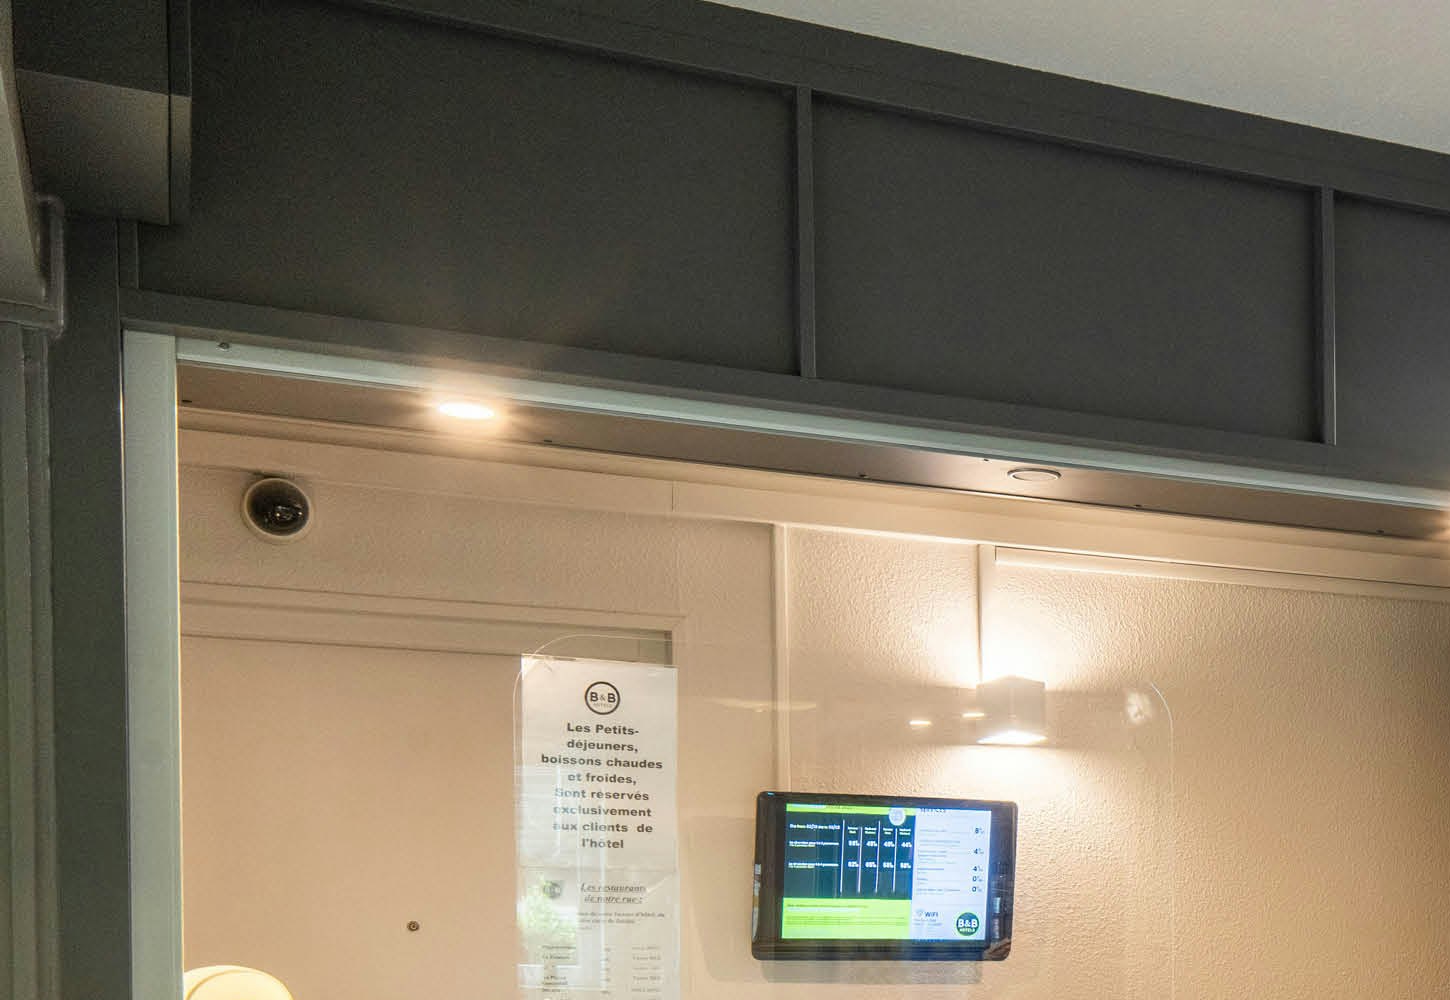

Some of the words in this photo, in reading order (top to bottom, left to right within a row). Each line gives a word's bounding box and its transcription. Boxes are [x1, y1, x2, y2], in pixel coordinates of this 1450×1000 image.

[590, 692, 616, 703] B&B
[567, 722, 590, 732] Les
[595, 724, 639, 735] Petits-
[567, 740, 638, 753] déjeuners,
[541, 754, 602, 766] boissons
[606, 757, 663, 769] chaudes
[568, 773, 582, 782] et
[586, 773, 637, 785] froides,
[554, 788, 586, 798] Sont
[591, 788, 650, 800] réservés
[553, 806, 652, 816] exclusivement
[553, 822, 577, 831] aux
[582, 822, 628, 832] clients
[636, 823, 653, 833] de
[582, 838, 624, 849] l'hôtel
[958, 919, 978, 928] B&B
